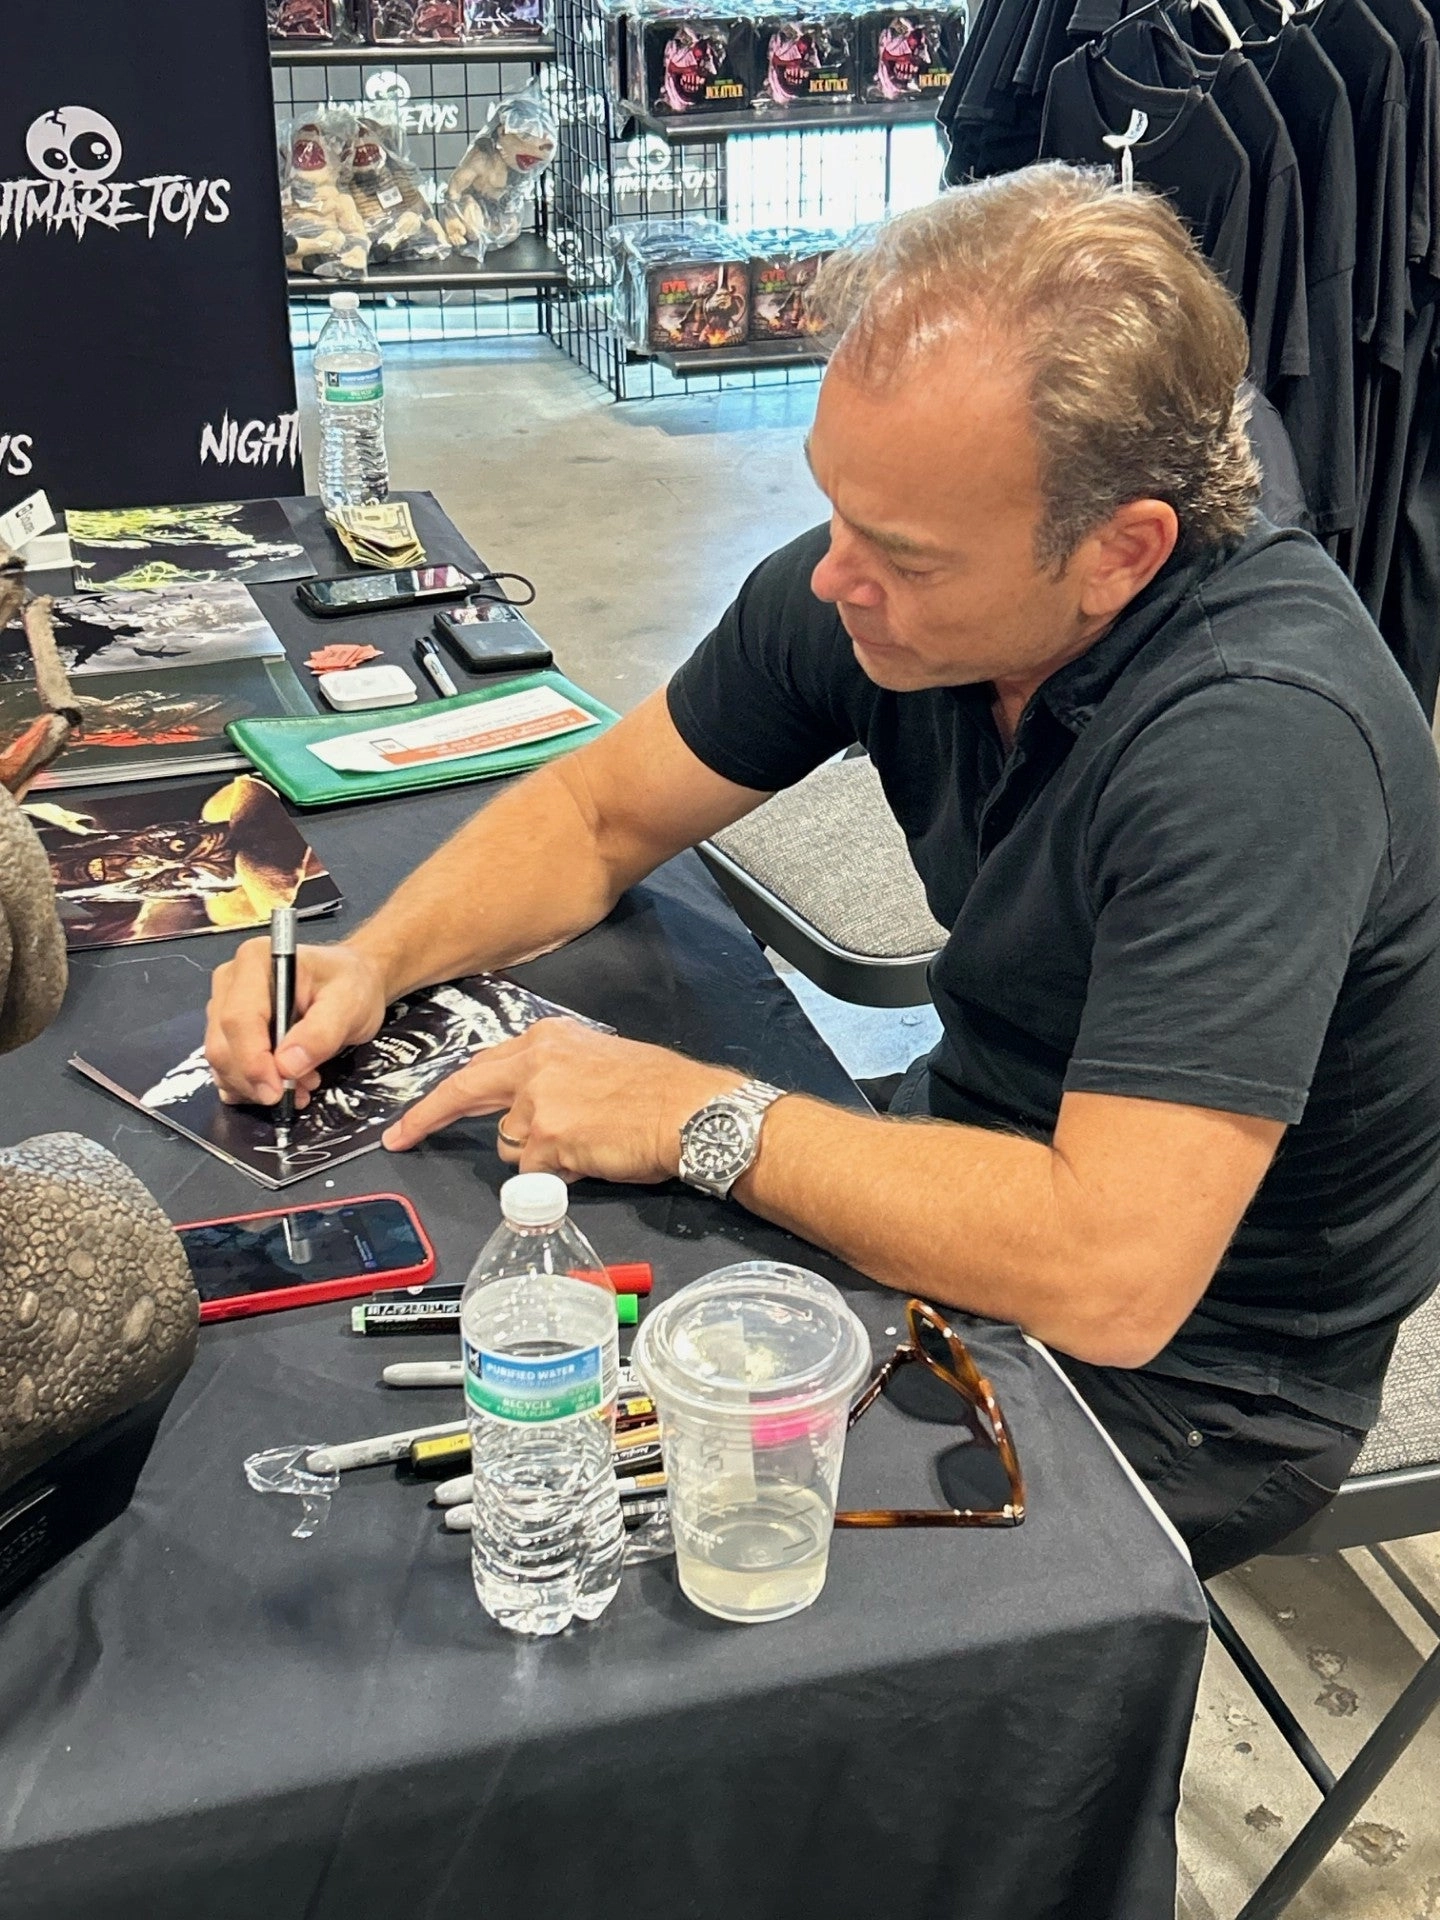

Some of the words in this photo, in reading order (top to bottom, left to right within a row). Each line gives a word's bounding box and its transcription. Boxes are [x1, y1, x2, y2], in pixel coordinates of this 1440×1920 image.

[137, 174, 231, 240] TOYS
[486, 1362, 535, 1380] PURIFIED
[537, 1363, 575, 1380] WATER
[502, 1396, 553, 1410] RECYCLE
